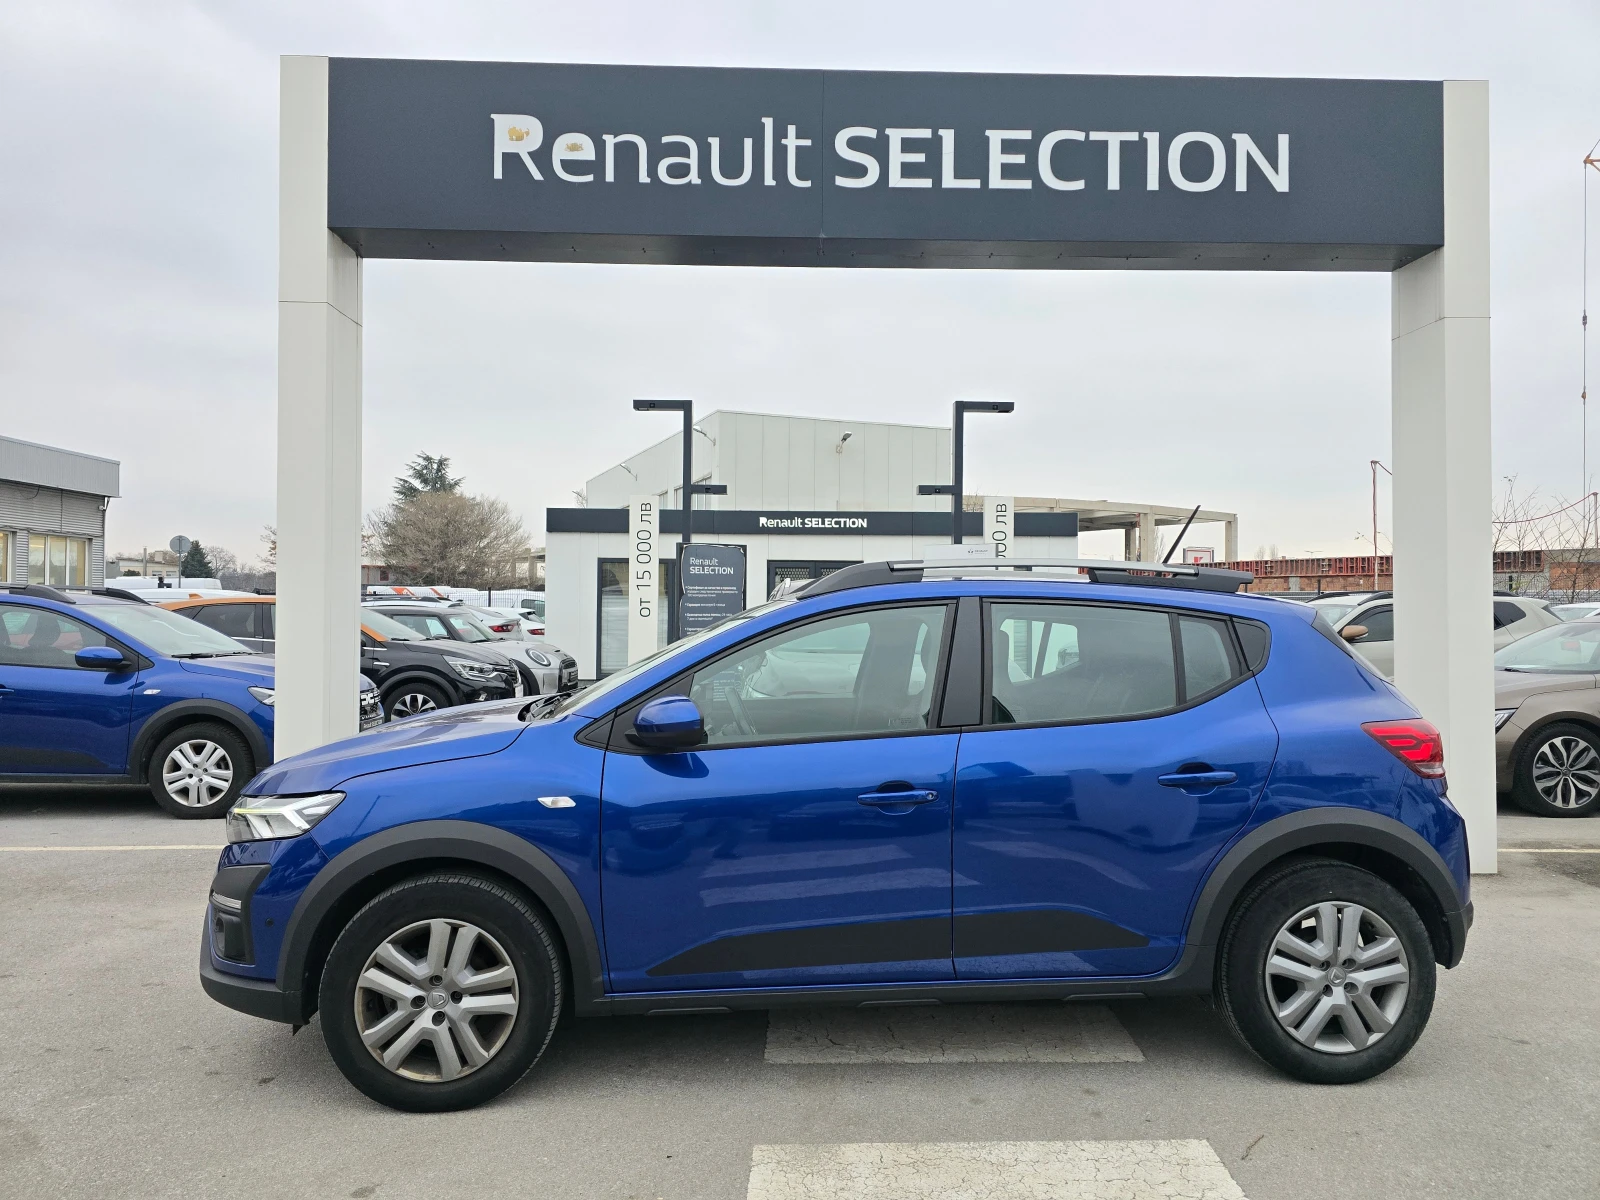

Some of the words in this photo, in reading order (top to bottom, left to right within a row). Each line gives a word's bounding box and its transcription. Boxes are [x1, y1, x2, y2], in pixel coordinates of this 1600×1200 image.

[490, 113, 812, 188] Renault
[834, 126, 1290, 193] SELECTION
[640, 502, 652, 525] лв
[759, 516, 802, 528] Renault
[804, 517, 868, 529] SELECTION
[995, 503, 1007, 525] лв
[636, 529, 651, 565] 000
[689, 557, 718, 566] Renault
[689, 566, 734, 575] SELECTION
[636, 571, 651, 591] 15
[640, 597, 651, 618] от
